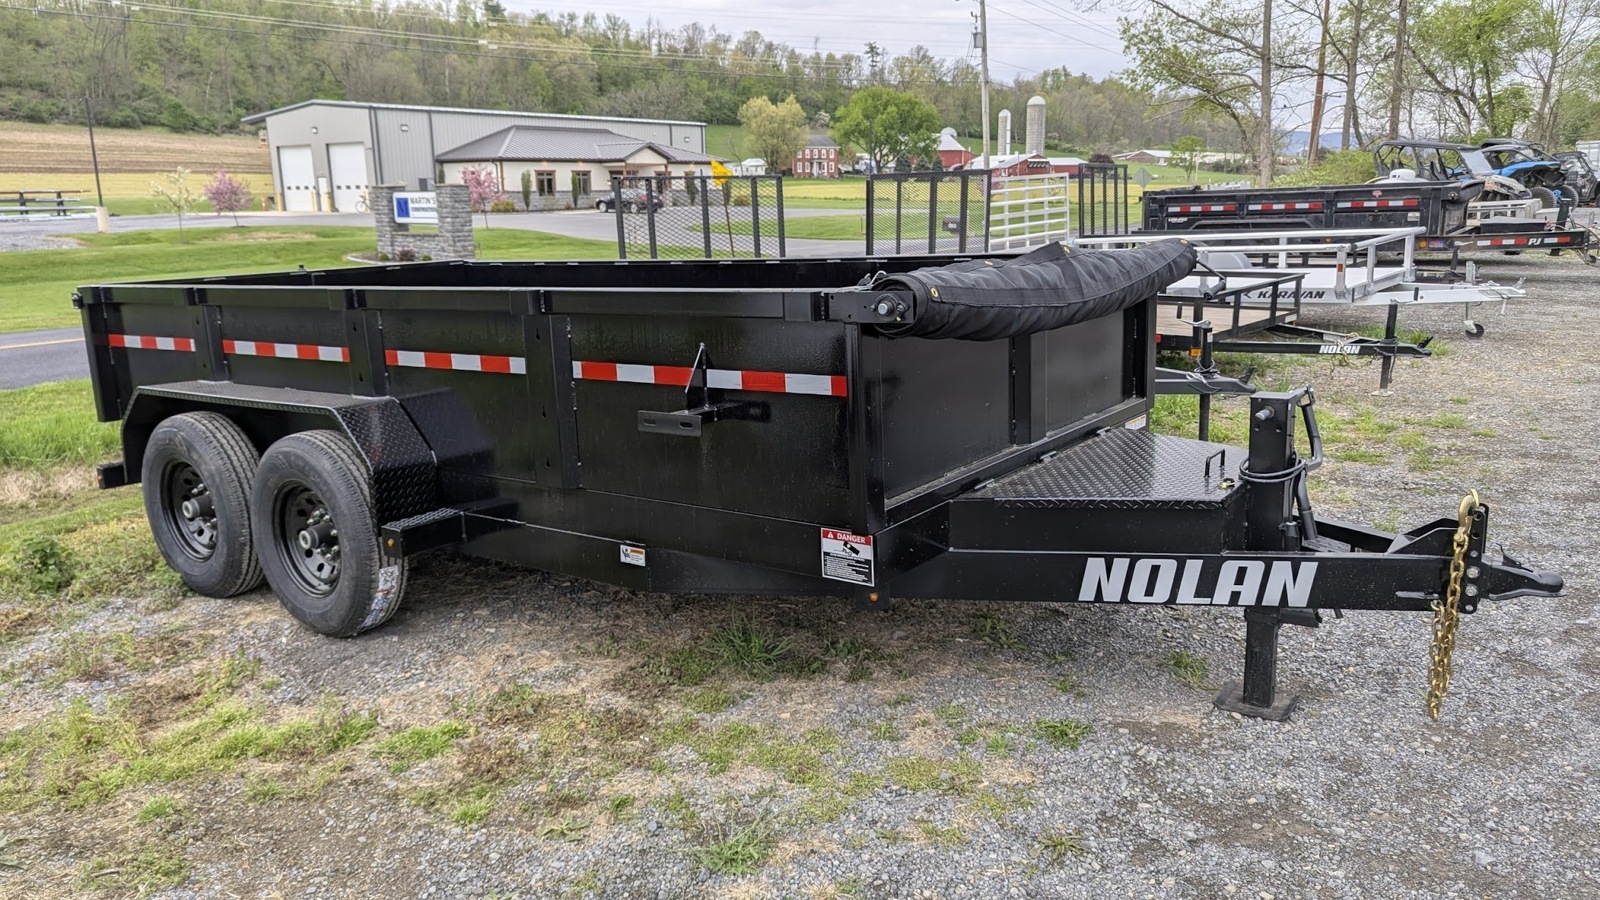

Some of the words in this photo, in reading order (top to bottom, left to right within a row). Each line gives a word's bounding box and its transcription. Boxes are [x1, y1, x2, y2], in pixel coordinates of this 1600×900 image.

[410, 196, 437, 205] MARTIN'S
[1528, 237, 1542, 246] PJ
[1318, 345, 1361, 355] NOLAN
[836, 532, 866, 544] DANGER
[1078, 557, 1319, 608] NOLAN
